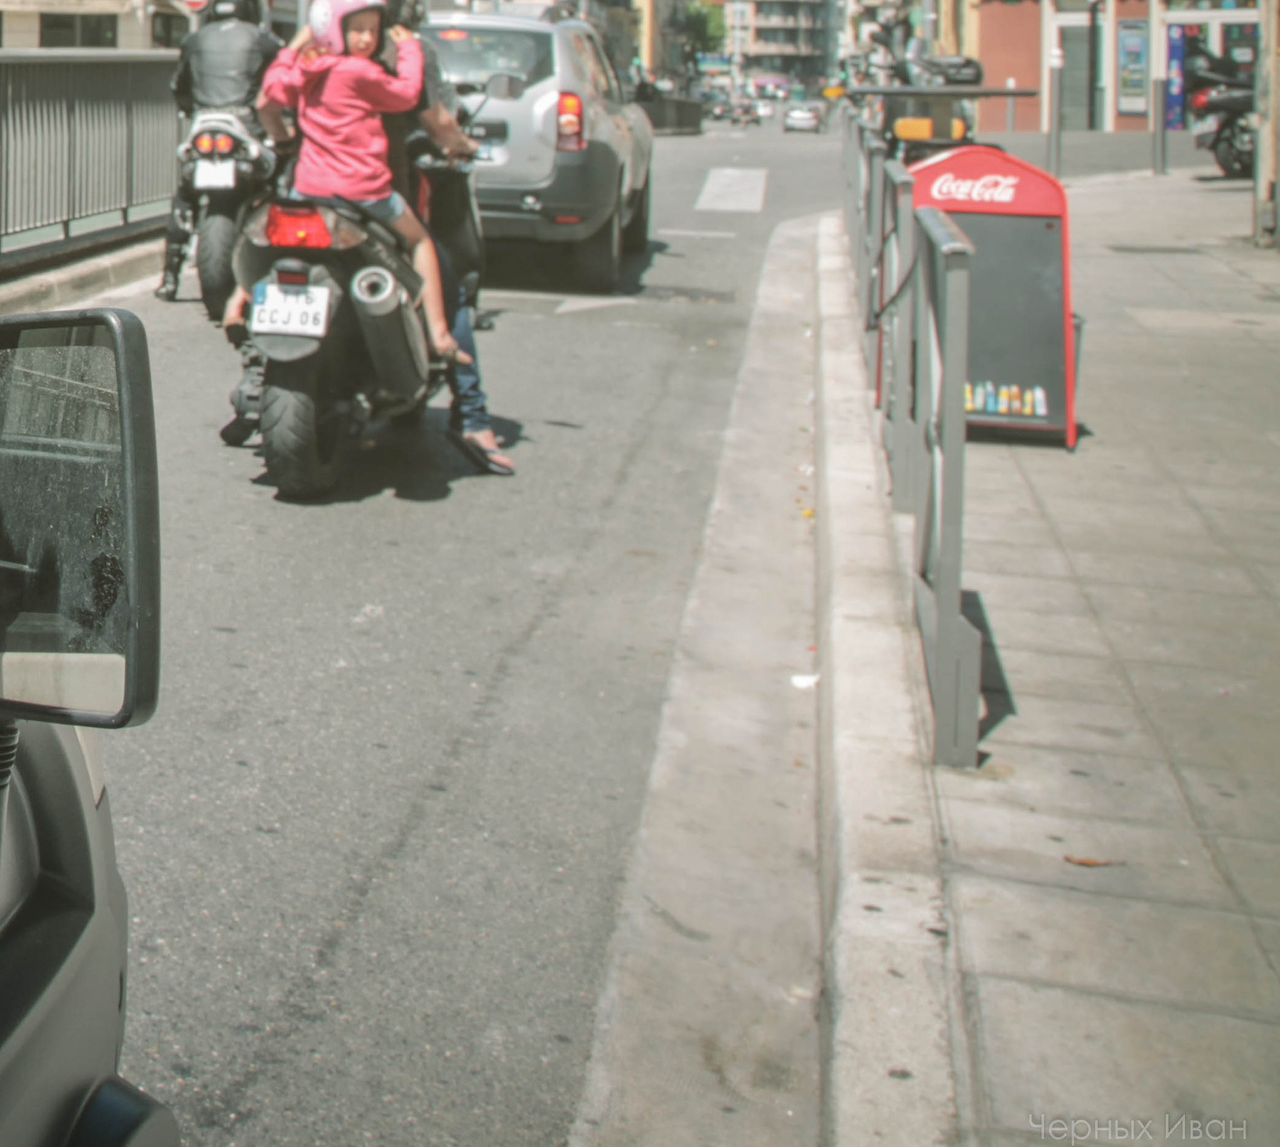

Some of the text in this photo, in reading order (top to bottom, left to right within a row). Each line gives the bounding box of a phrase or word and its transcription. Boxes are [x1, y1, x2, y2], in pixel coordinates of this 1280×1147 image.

[931, 173, 1020, 203] Coca-Cola
[257, 308, 322, 326] CCJ 06
